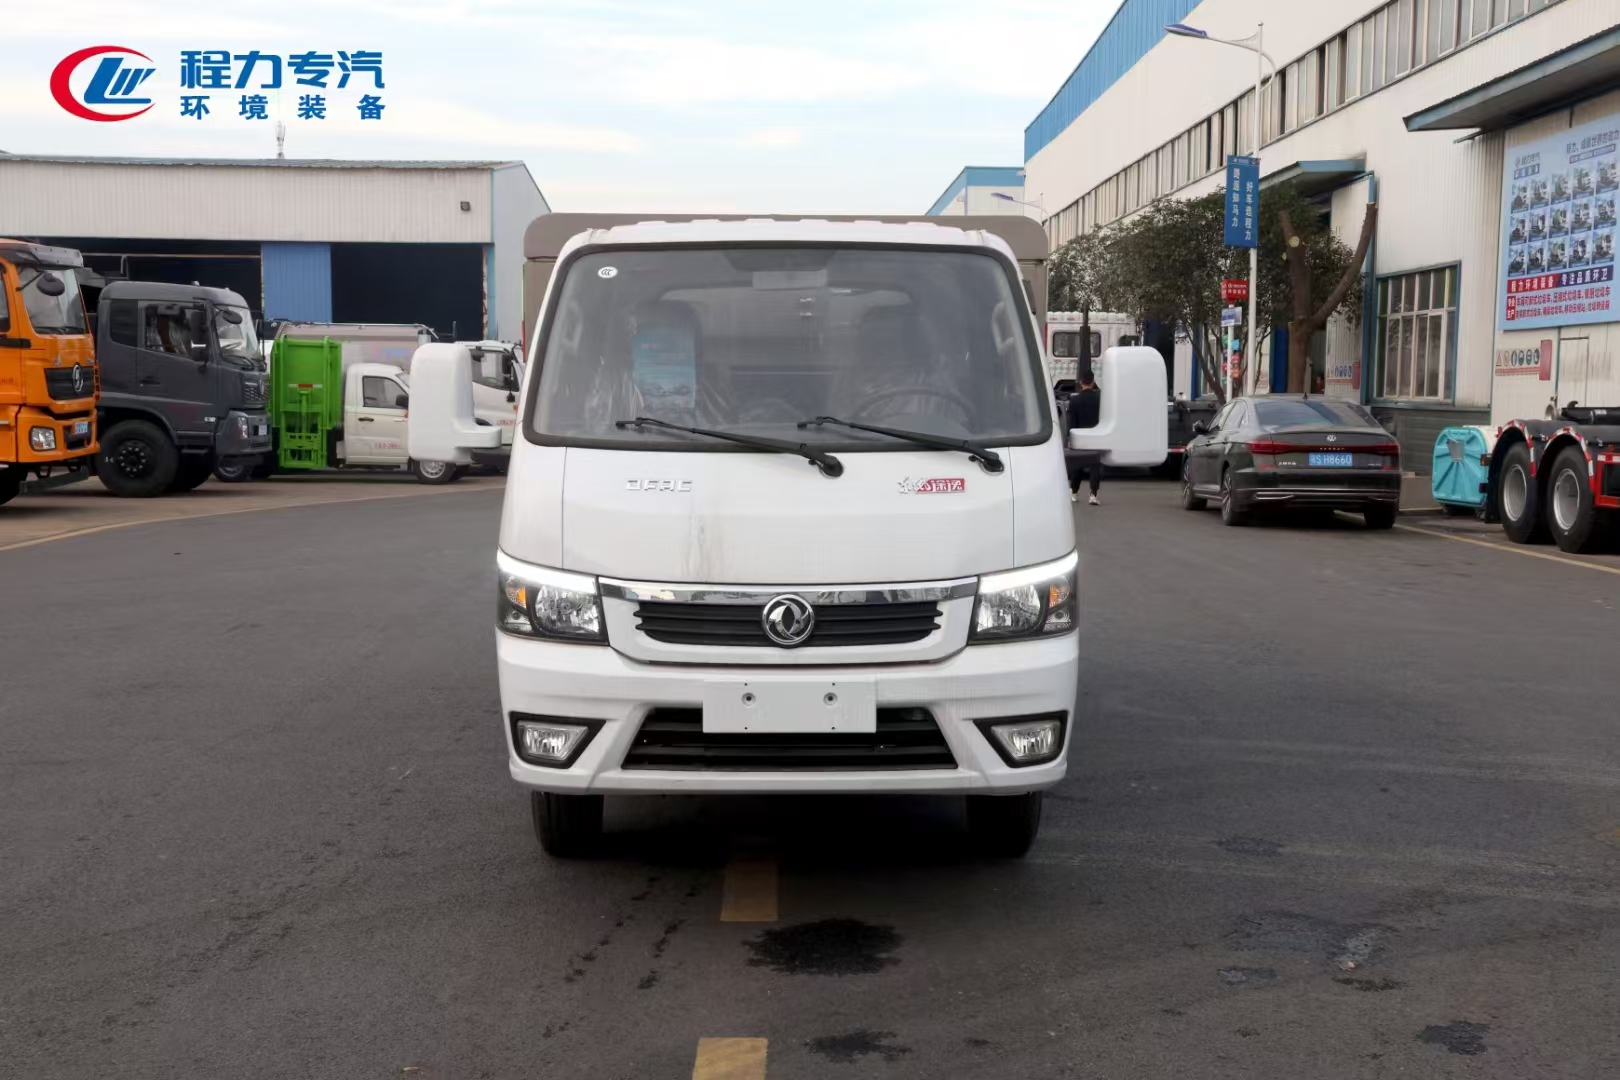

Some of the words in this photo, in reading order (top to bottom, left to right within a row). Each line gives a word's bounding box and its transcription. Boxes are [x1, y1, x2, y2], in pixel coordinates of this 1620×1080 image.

[1244, 181, 1254, 241] 好车选程力
[1511, 275, 1554, 292] 程力环境装备
[1562, 268, 1608, 285] 专注品质环卫
[626, 480, 693, 492] DFAC
